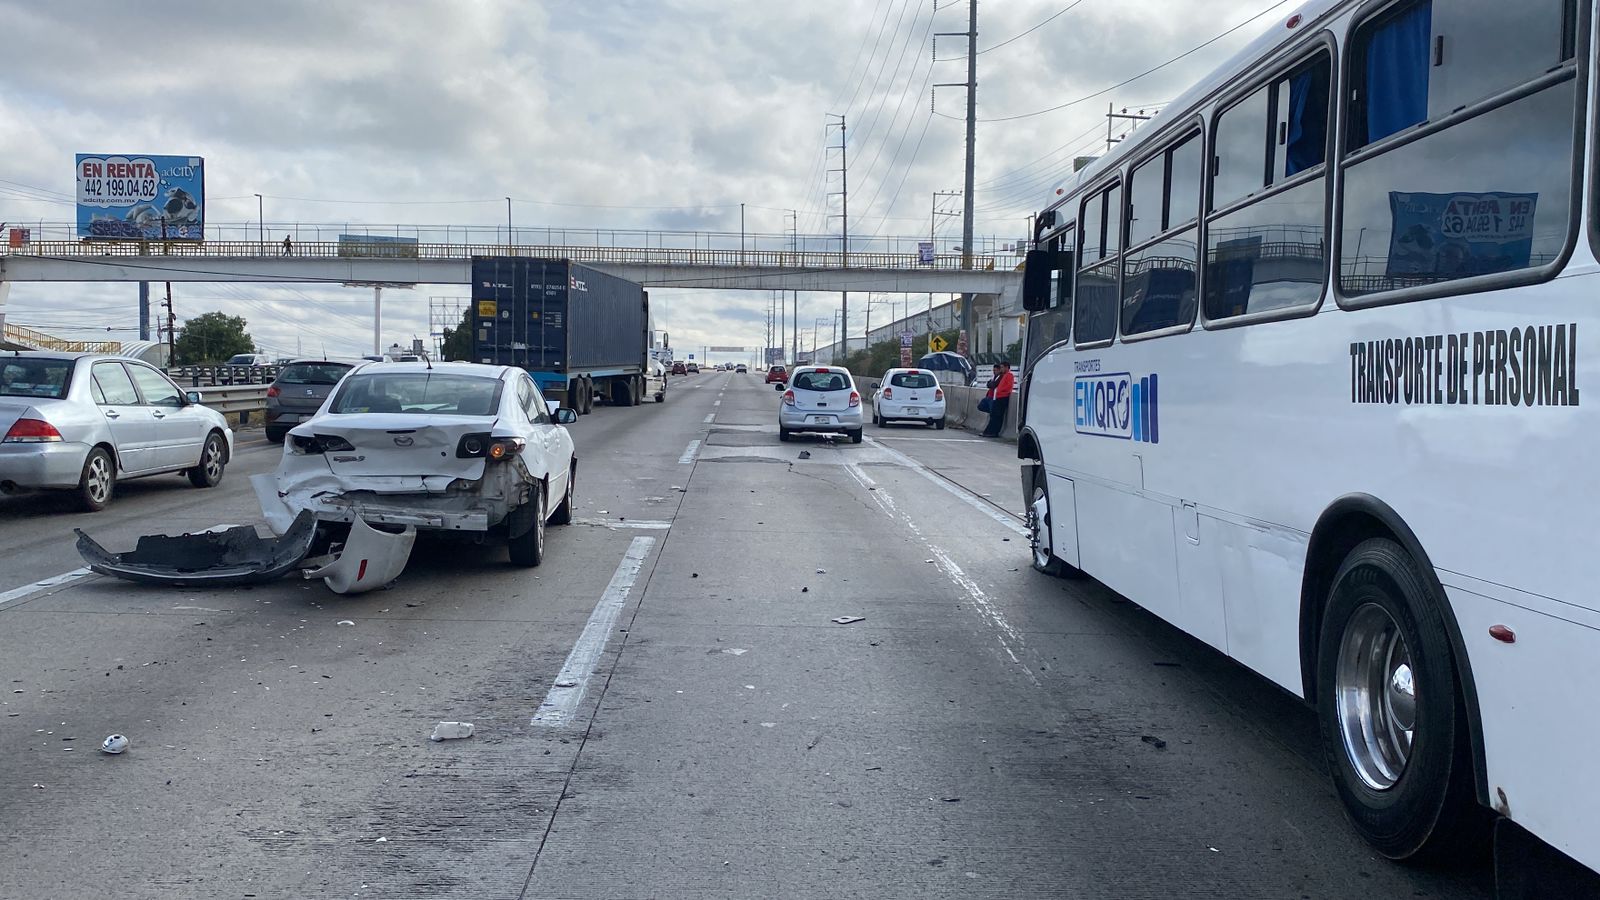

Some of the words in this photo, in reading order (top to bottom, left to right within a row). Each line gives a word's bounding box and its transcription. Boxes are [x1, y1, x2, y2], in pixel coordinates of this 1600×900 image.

[83, 163, 102, 178] EN
[107, 163, 155, 178] RENTA
[85, 179, 102, 196] 442
[106, 179, 155, 196] 199.04.62
[1074, 359, 1101, 372] TRANSPORTES
[1350, 335, 1443, 405] TRANSPORTE
[1447, 333, 1468, 405] DE
[1473, 323, 1580, 407] PERSONAL
[1075, 380, 1130, 432] EMQRO
